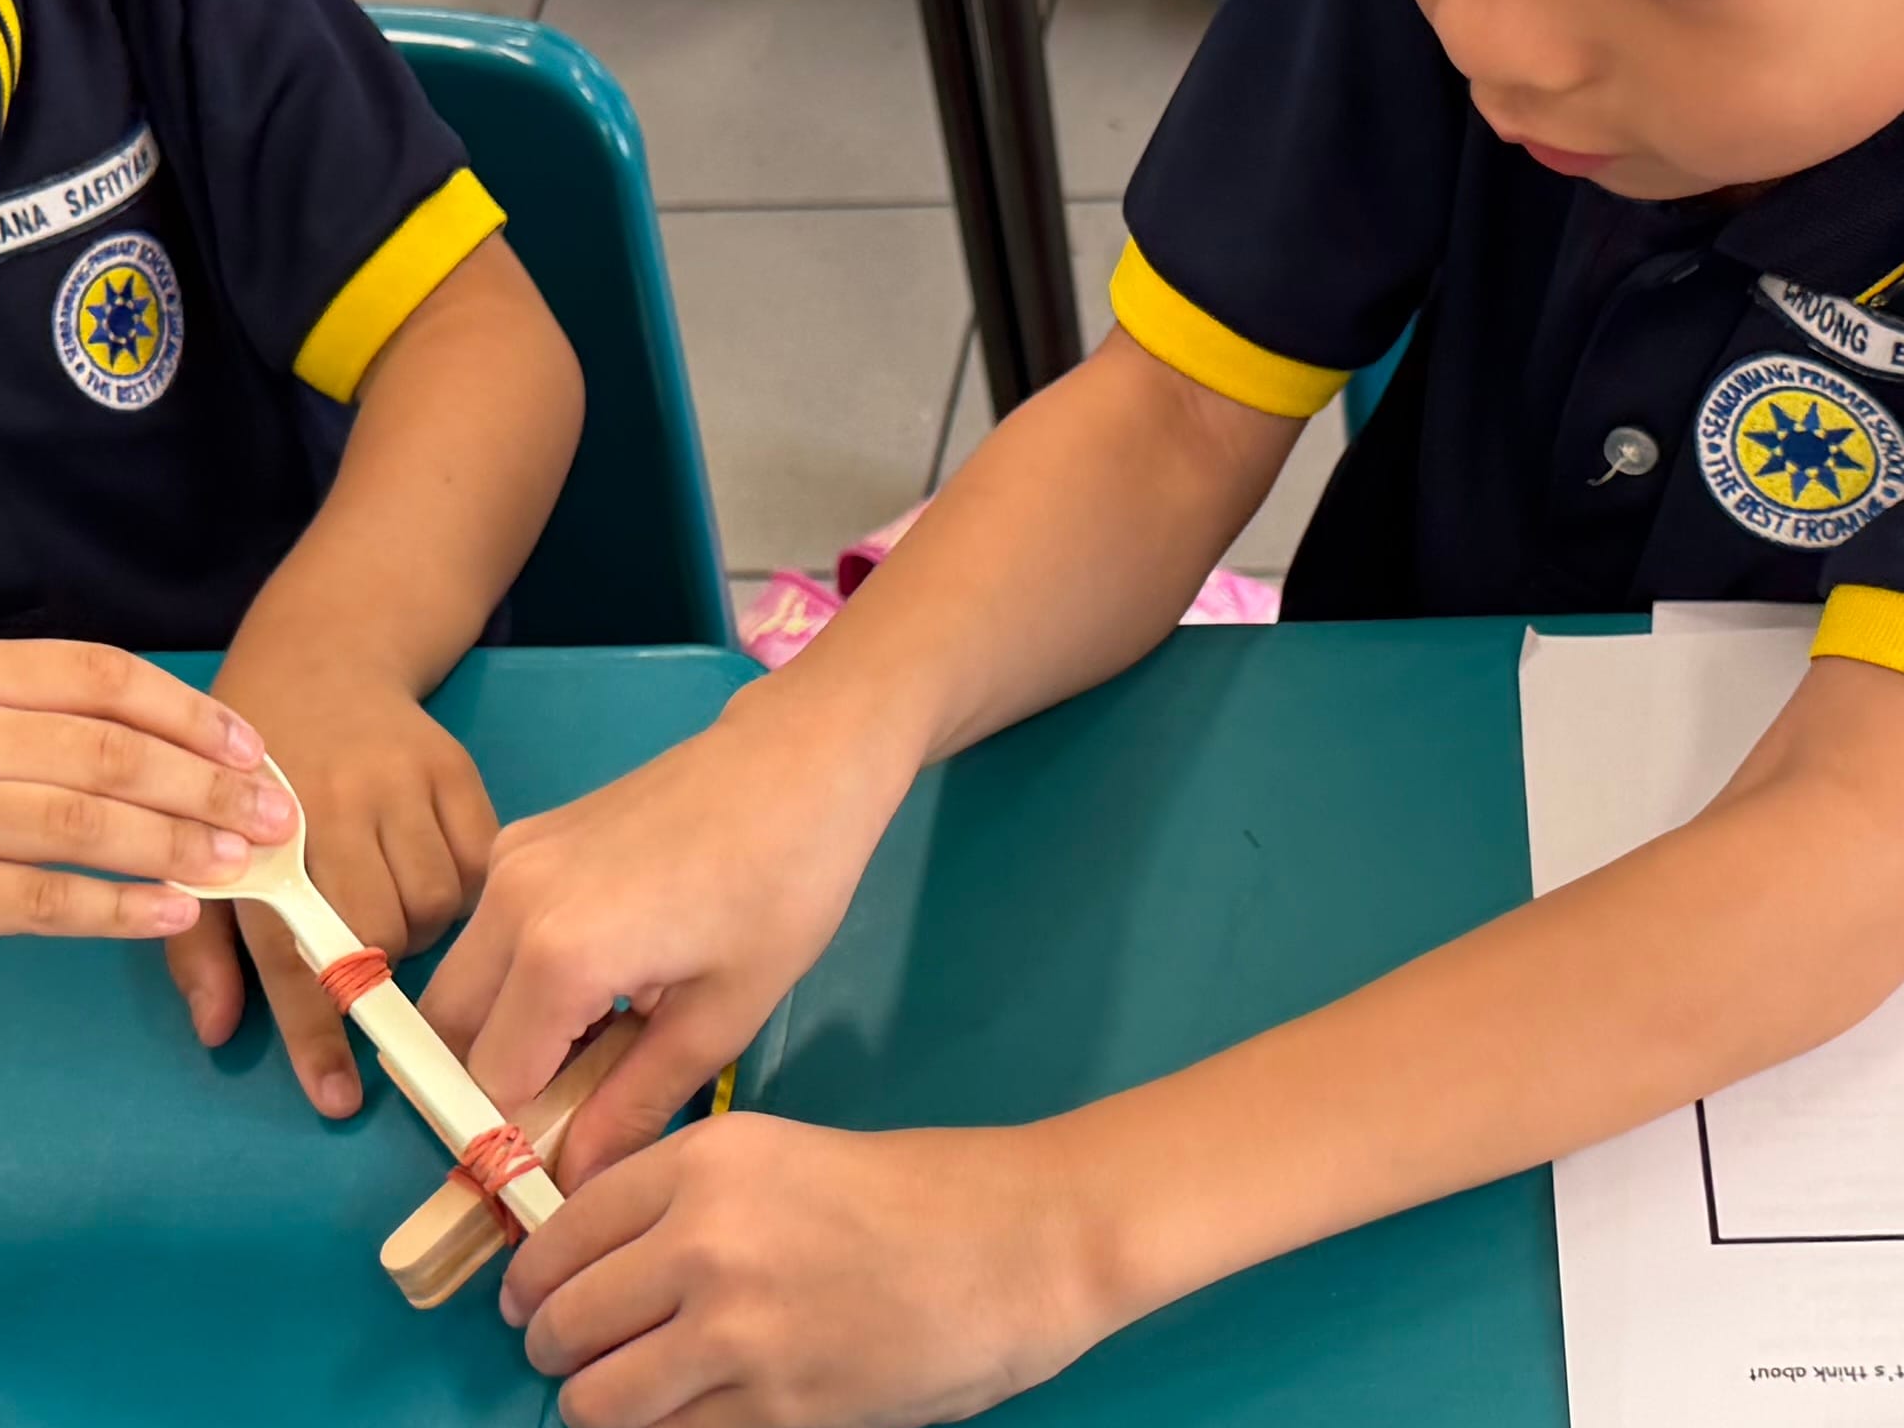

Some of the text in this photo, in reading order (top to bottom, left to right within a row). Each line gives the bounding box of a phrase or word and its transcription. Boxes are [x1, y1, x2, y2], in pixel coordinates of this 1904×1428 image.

[1704, 454, 1737, 500] THE
[1734, 493, 1793, 535] BEST
[1796, 514, 1860, 543] FROM
[1749, 1366, 1807, 1383] about
[1812, 1365, 1868, 1383] think
